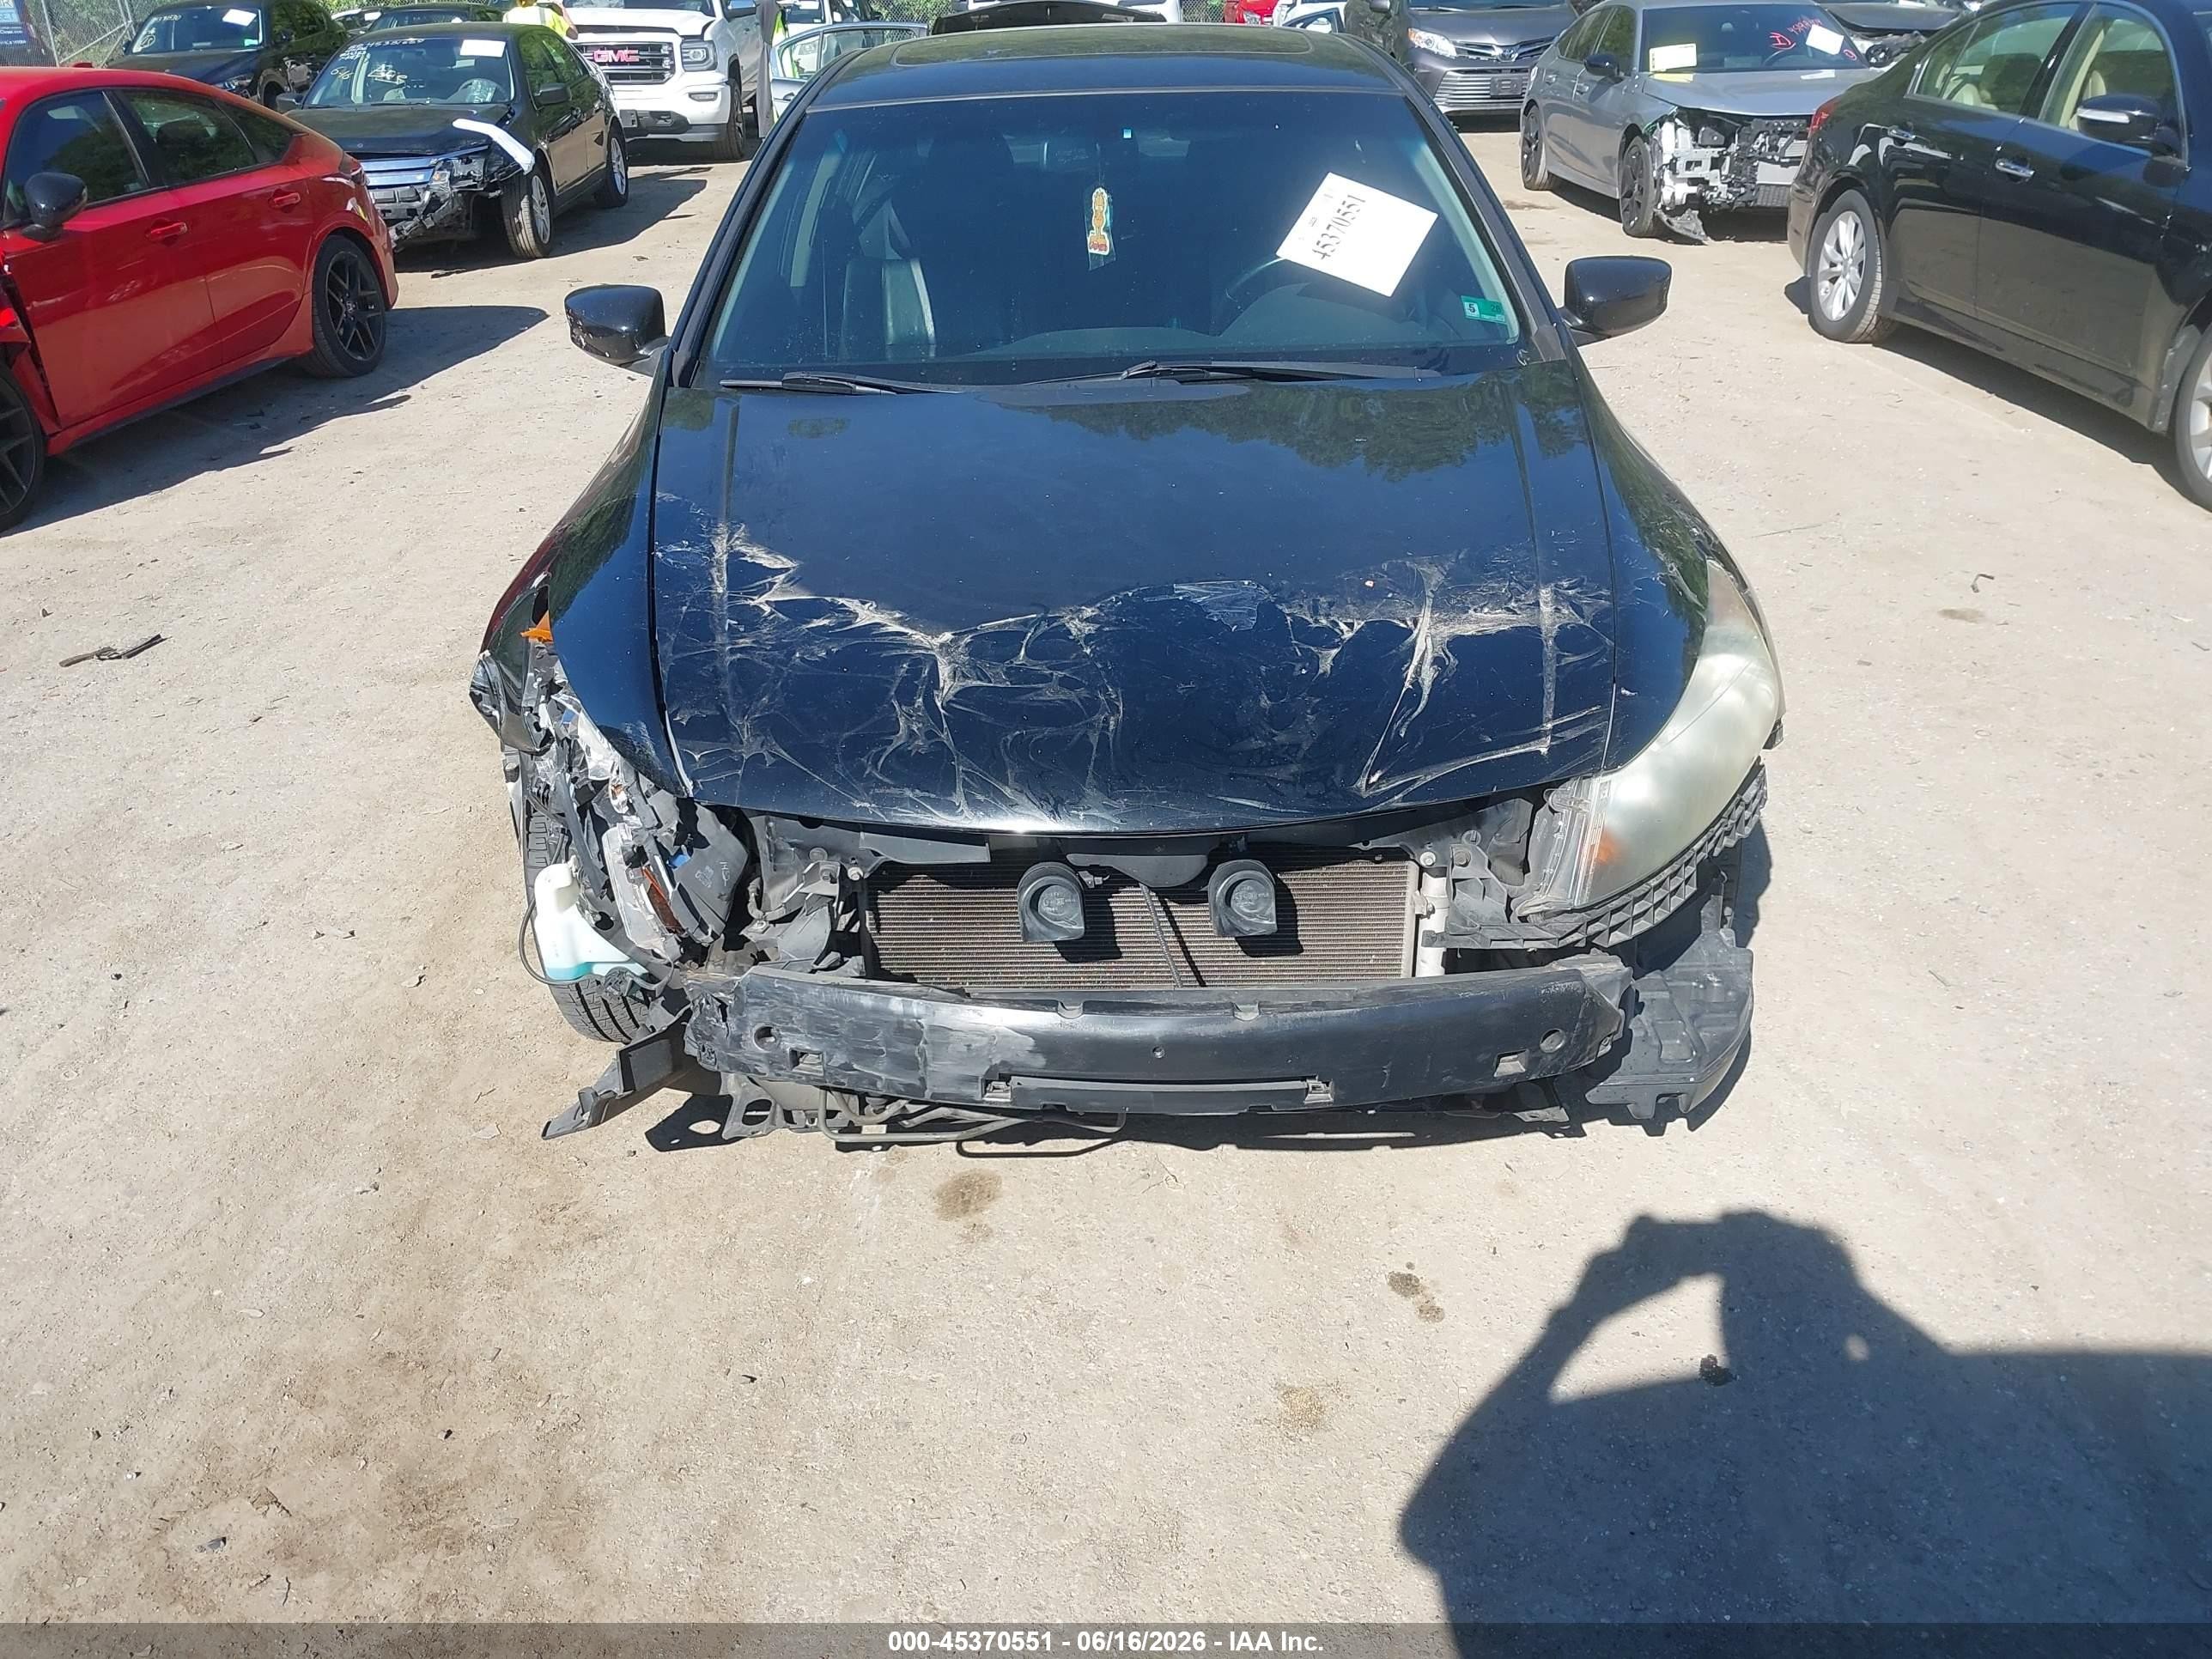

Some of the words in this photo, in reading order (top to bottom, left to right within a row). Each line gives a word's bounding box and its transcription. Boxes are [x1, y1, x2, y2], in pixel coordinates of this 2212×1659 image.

[593, 49, 640, 63] GMC
[1311, 194, 1367, 260] 45370551
[1468, 304, 1475, 313] 5
